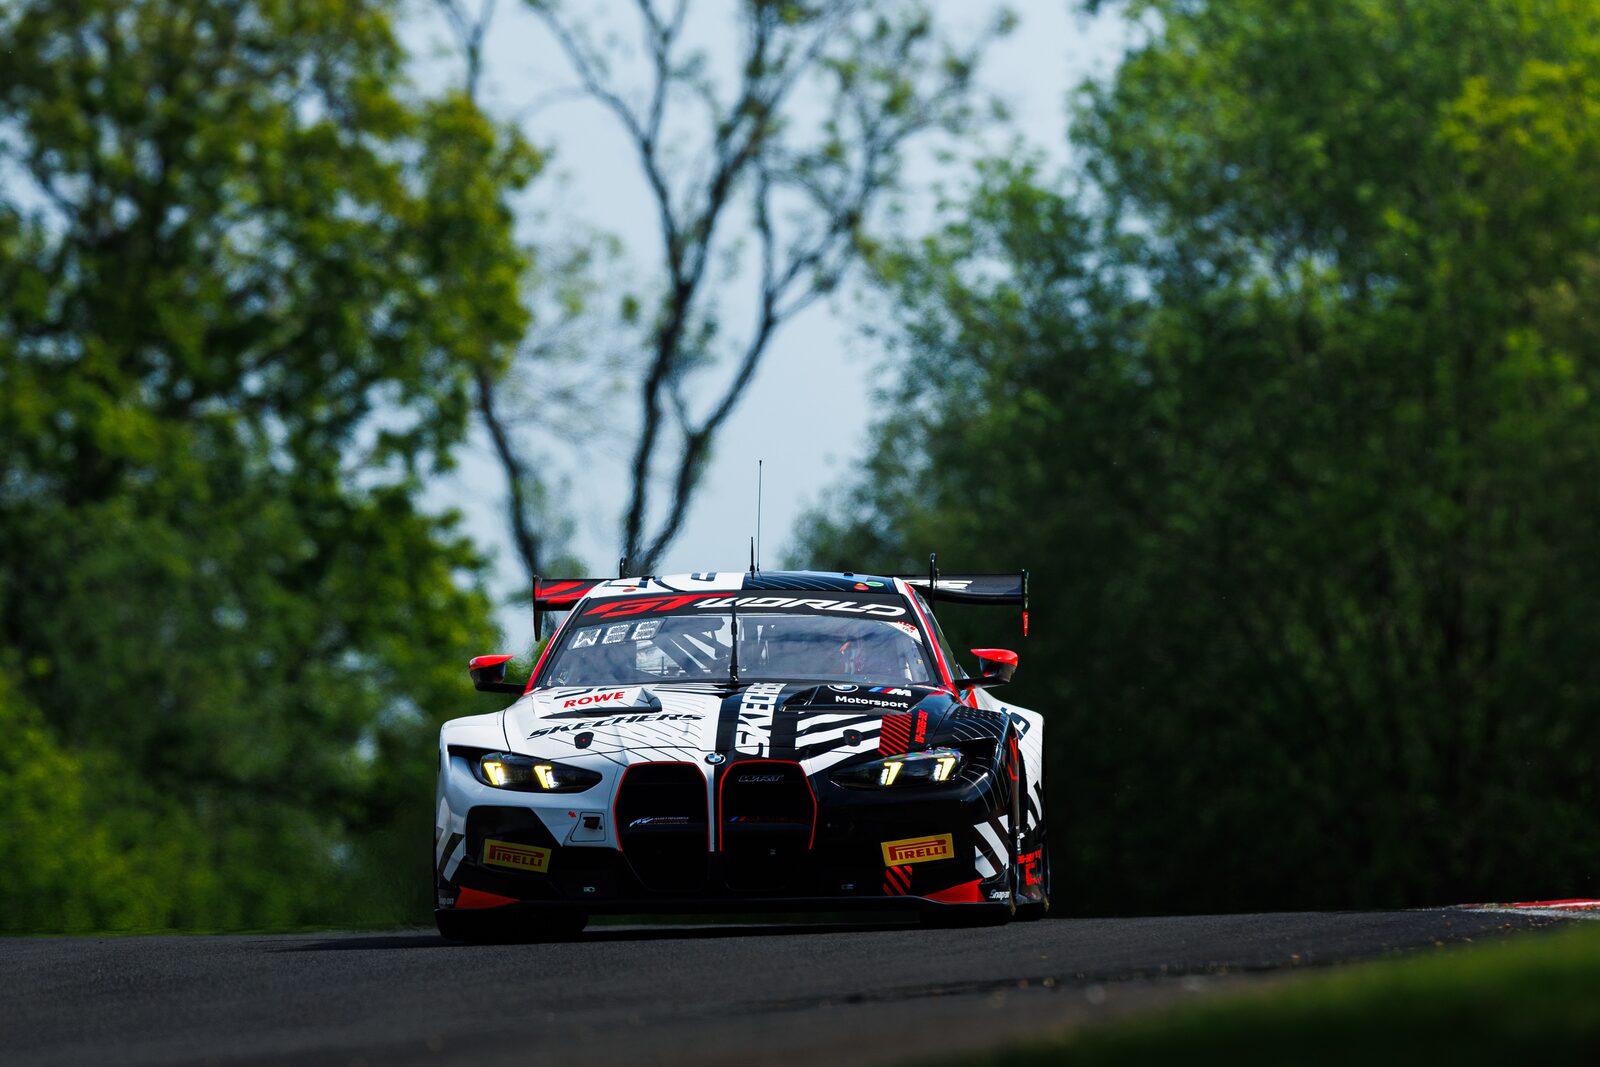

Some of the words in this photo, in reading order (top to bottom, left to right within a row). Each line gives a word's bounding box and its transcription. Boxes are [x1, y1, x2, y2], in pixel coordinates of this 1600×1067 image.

[583, 592, 736, 618] GT
[693, 597, 906, 616] WORLD
[563, 691, 625, 708] ROWE
[835, 695, 909, 709] Motorsport
[526, 713, 706, 741] SKECHERS
[488, 844, 544, 867] PIRELLI
[888, 838, 947, 861] PIRELLI
